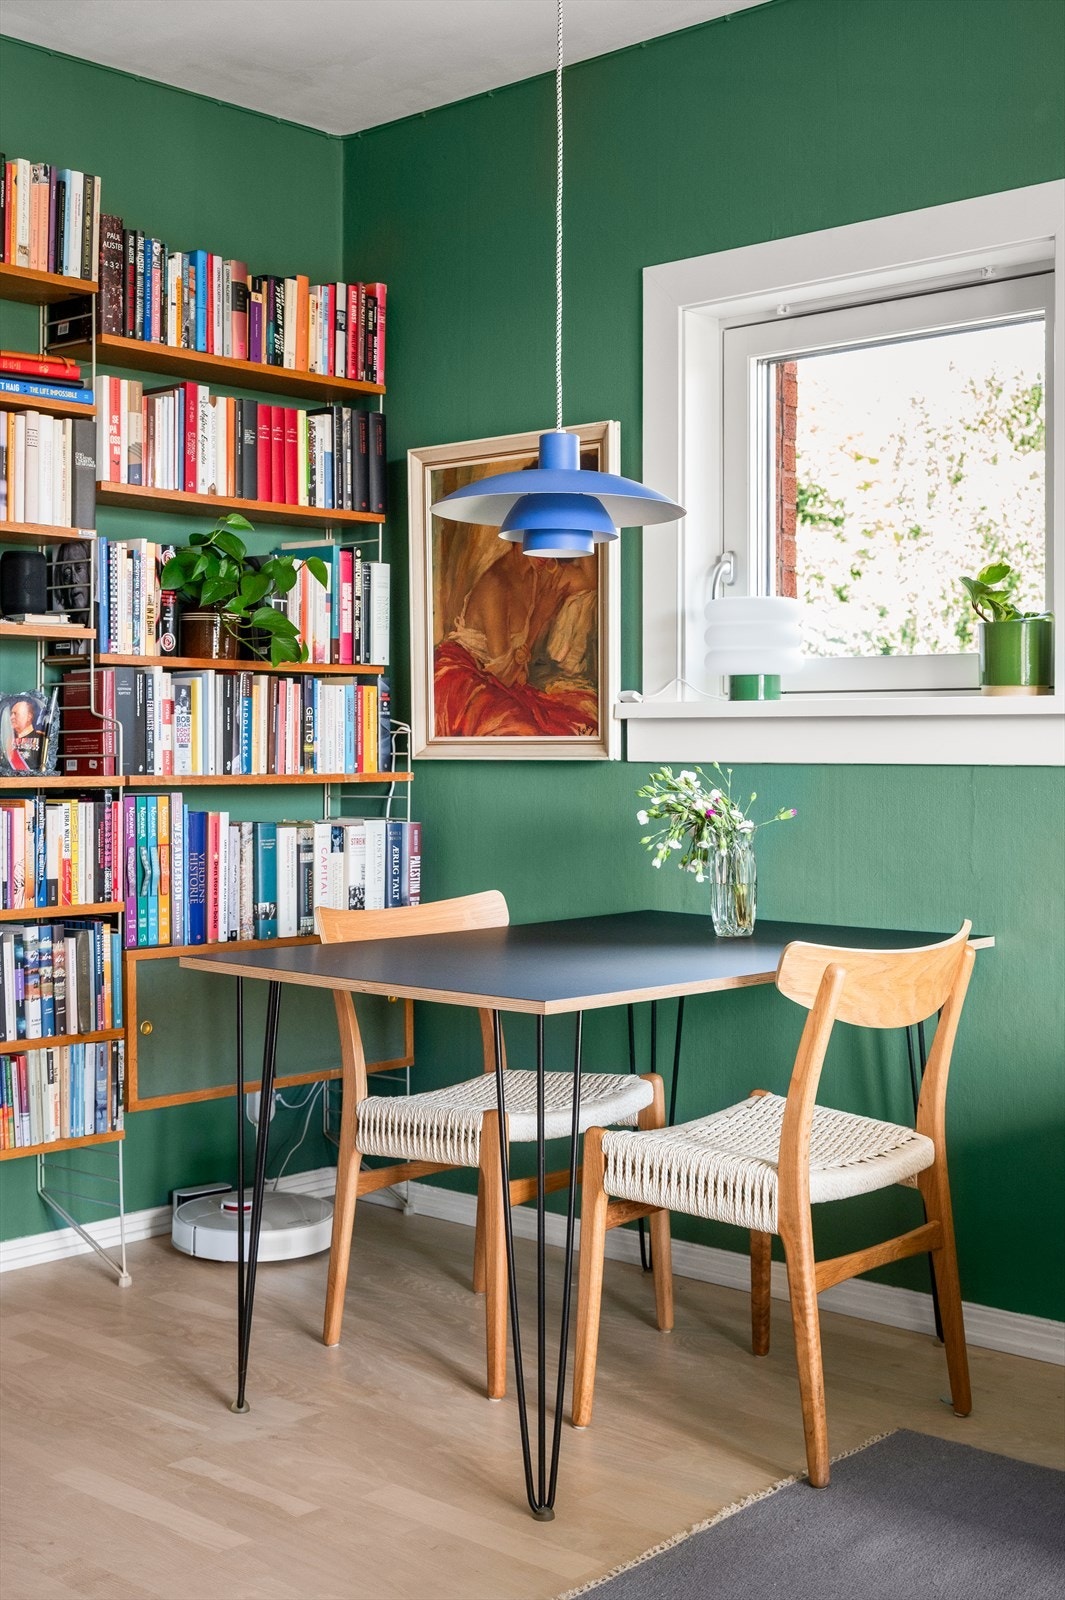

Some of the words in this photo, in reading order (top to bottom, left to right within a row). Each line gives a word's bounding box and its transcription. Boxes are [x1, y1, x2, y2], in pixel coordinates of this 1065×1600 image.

[107, 232, 120, 241] PAUL
[6, 383, 19, 392] HAIG
[50, 389, 77, 399] IMPOSSIBLE
[200, 410, 208, 432] Jeffrey
[148, 678, 153, 688] WE
[190, 852, 199, 904] HISTORIE
[410, 856, 421, 894] PALESTINA
